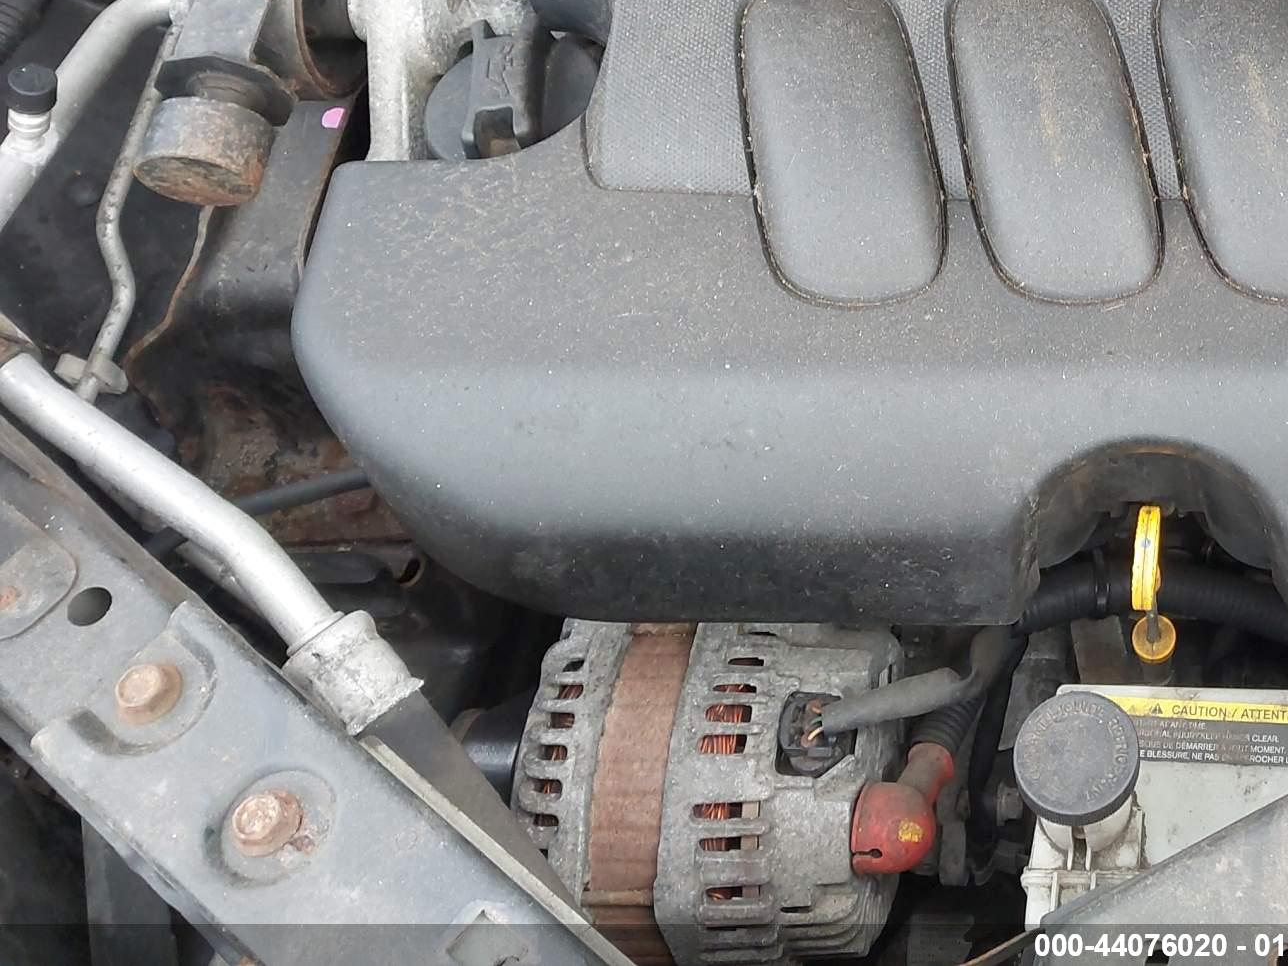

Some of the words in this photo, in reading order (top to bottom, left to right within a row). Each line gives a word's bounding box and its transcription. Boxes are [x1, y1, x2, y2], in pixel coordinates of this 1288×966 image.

[1172, 704, 1227, 717] CAUTION
[1252, 733, 1279, 743] CLEAR.
[1250, 745, 1287, 754] MOMENT.
[1191, 752, 1202, 761] NE
[1204, 752, 1220, 762] PAS
